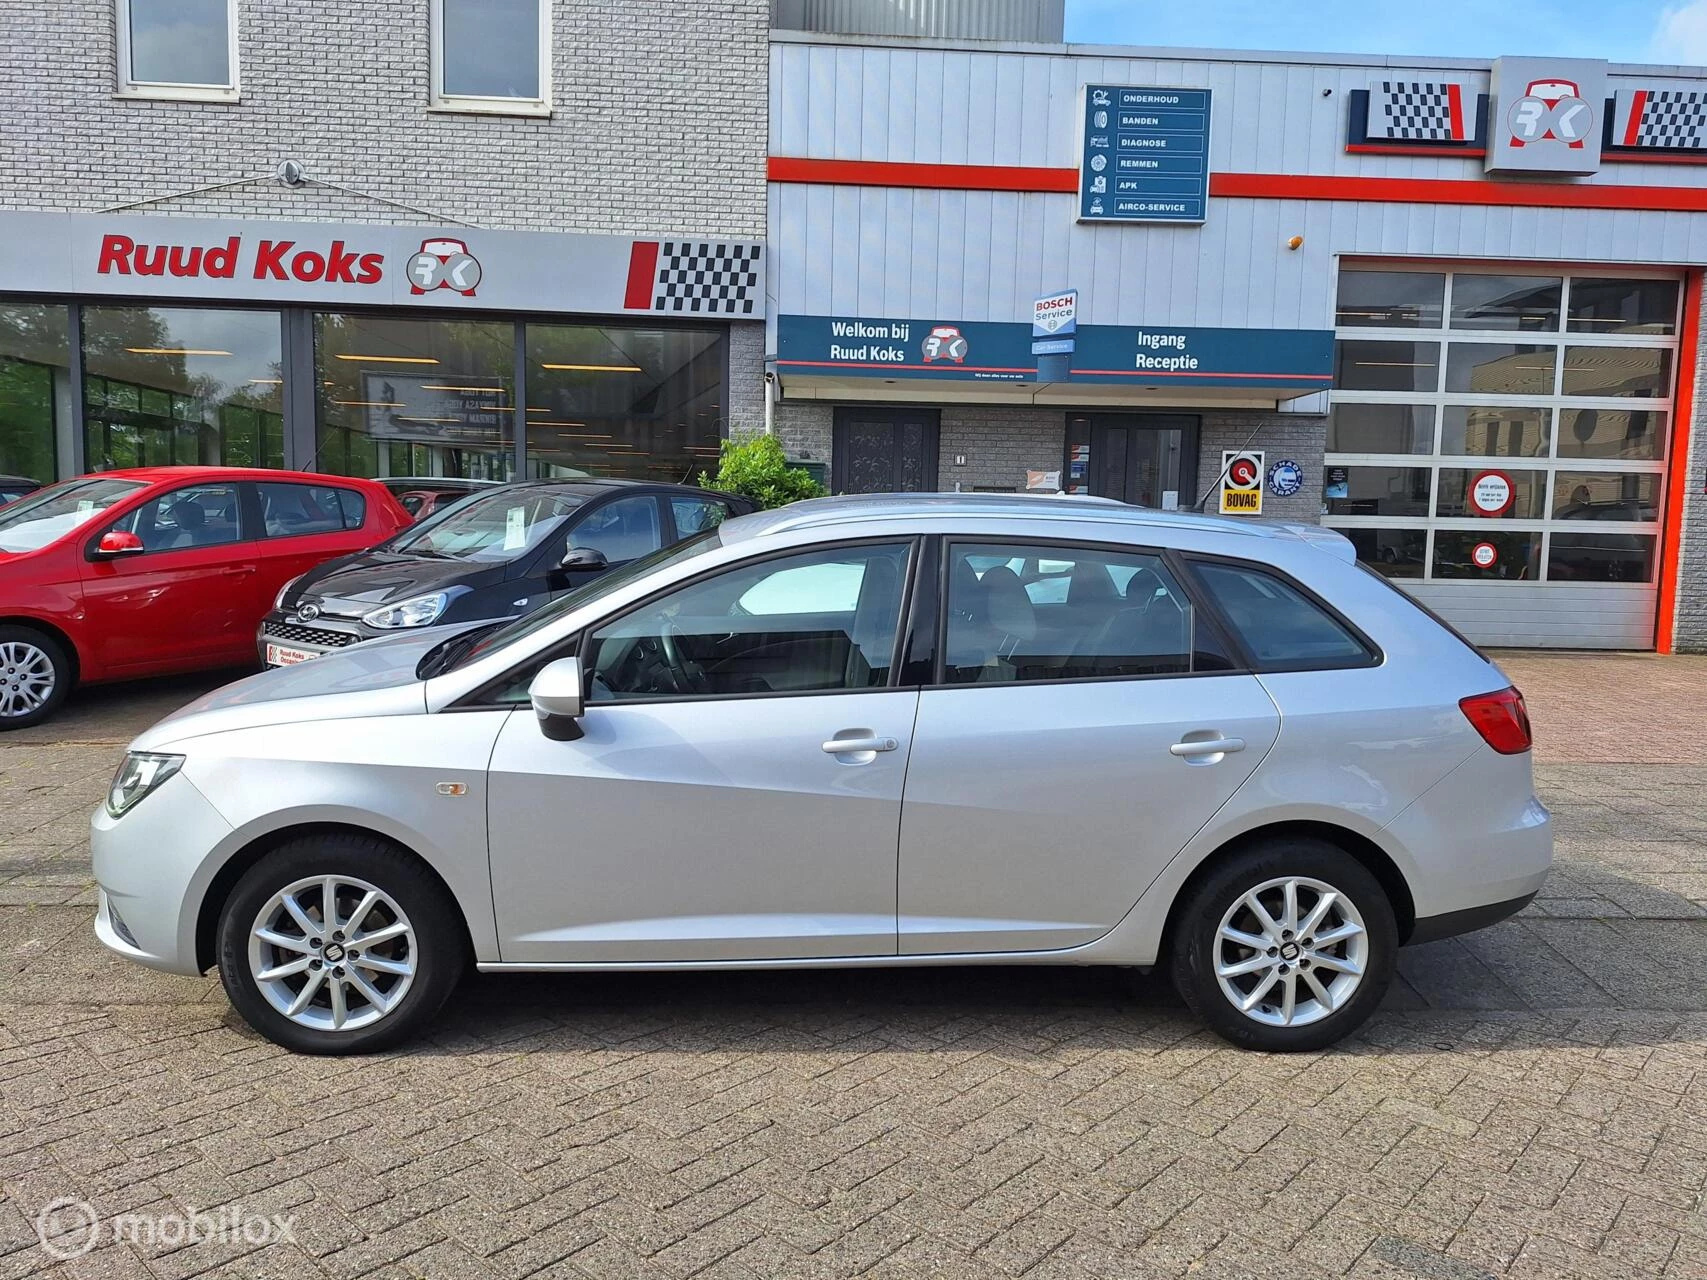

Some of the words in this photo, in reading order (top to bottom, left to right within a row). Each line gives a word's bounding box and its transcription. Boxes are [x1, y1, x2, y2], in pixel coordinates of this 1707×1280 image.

[1123, 94, 1179, 104] ONDERHOUD
[1122, 116, 1159, 125] BANDEN
[1121, 138, 1167, 148] DIAGNOSE
[1120, 159, 1159, 169] REMMEN
[1119, 181, 1138, 190] APK
[1118, 202, 1186, 212] AIRCO-SERVICE
[97, 234, 241, 279] Ruud
[253, 240, 384, 284] Koks
[1036, 296, 1073, 311] BOSCH
[1035, 308, 1073, 321] Service
[831, 321, 888, 338] Welkom
[891, 323, 910, 342] bij
[1137, 331, 1186, 350] Ingang
[830, 344, 867, 361] Ruud
[870, 346, 905, 362] Koks
[1135, 353, 1198, 372] Receptie
[1269, 461, 1302, 477] SCHADE
[1268, 481, 1301, 496] GARANT
[1226, 493, 1257, 508] BOVAG
[279, 649, 292, 658] Ruud
